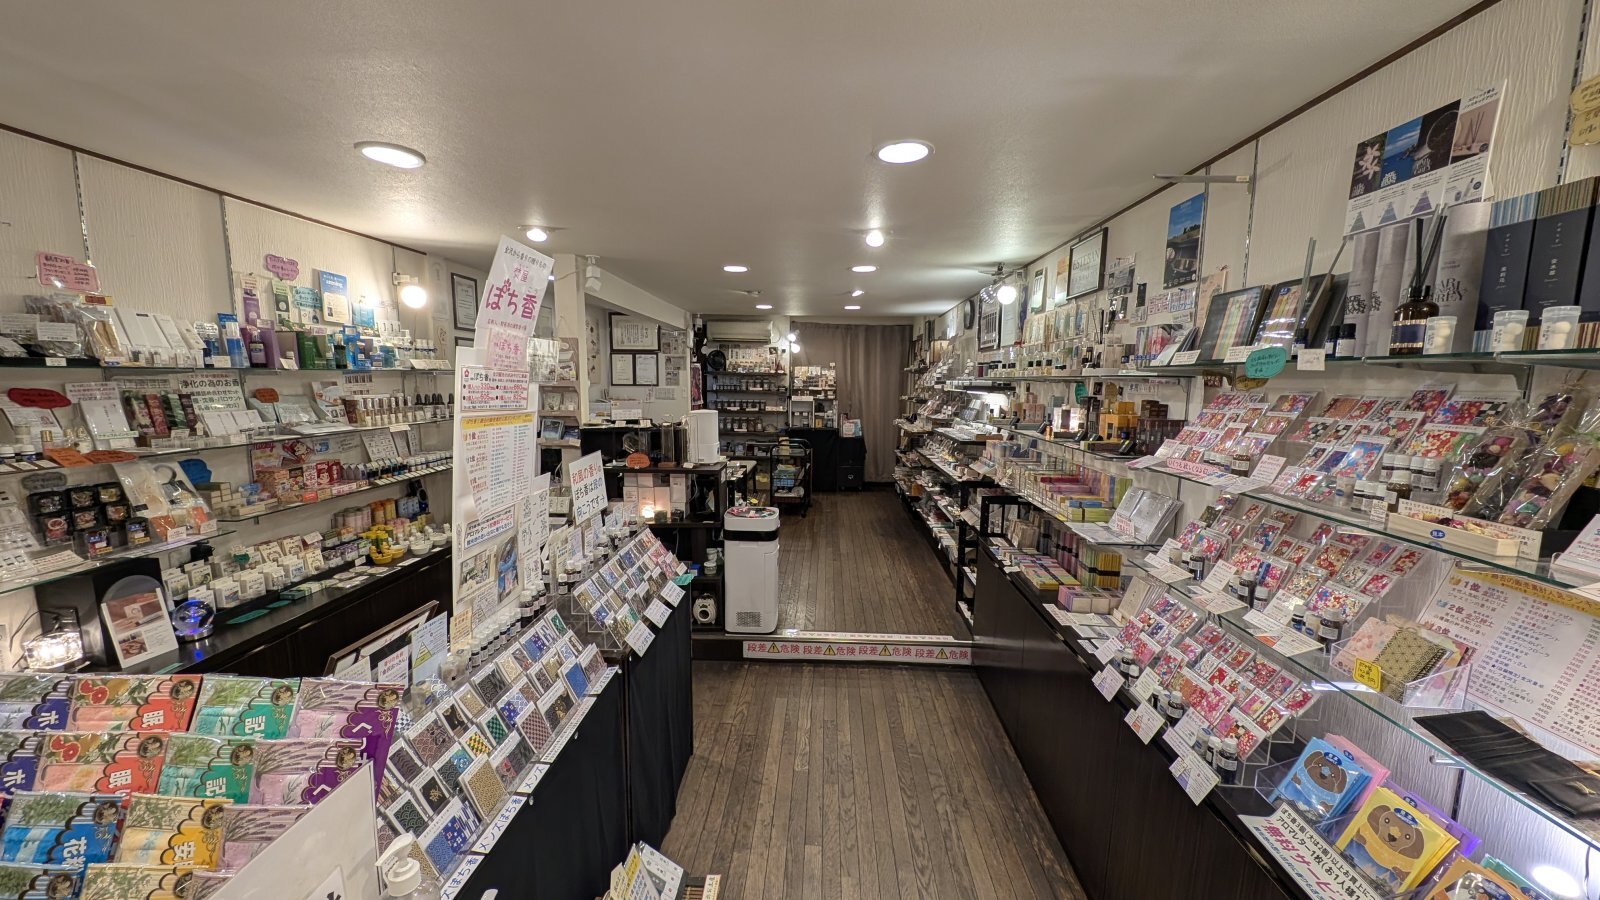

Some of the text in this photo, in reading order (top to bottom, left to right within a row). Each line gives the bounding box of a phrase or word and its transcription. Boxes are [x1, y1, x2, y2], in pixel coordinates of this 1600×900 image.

[486, 278, 538, 320] ぽち香
[180, 378, 240, 389] 浄化の為のお香
[1431, 530, 1443, 538] 見本
[1463, 580, 1481, 593] 1位
[1448, 603, 1465, 615] 2位
[1464, 612, 1495, 628] 金沢紳士
[747, 642, 969, 660] 段差 危険 段差 危険 段差 危険 段差 危険
[524, 765, 546, 790] メンズ
[479, 797, 524, 852] メンズぽち香
